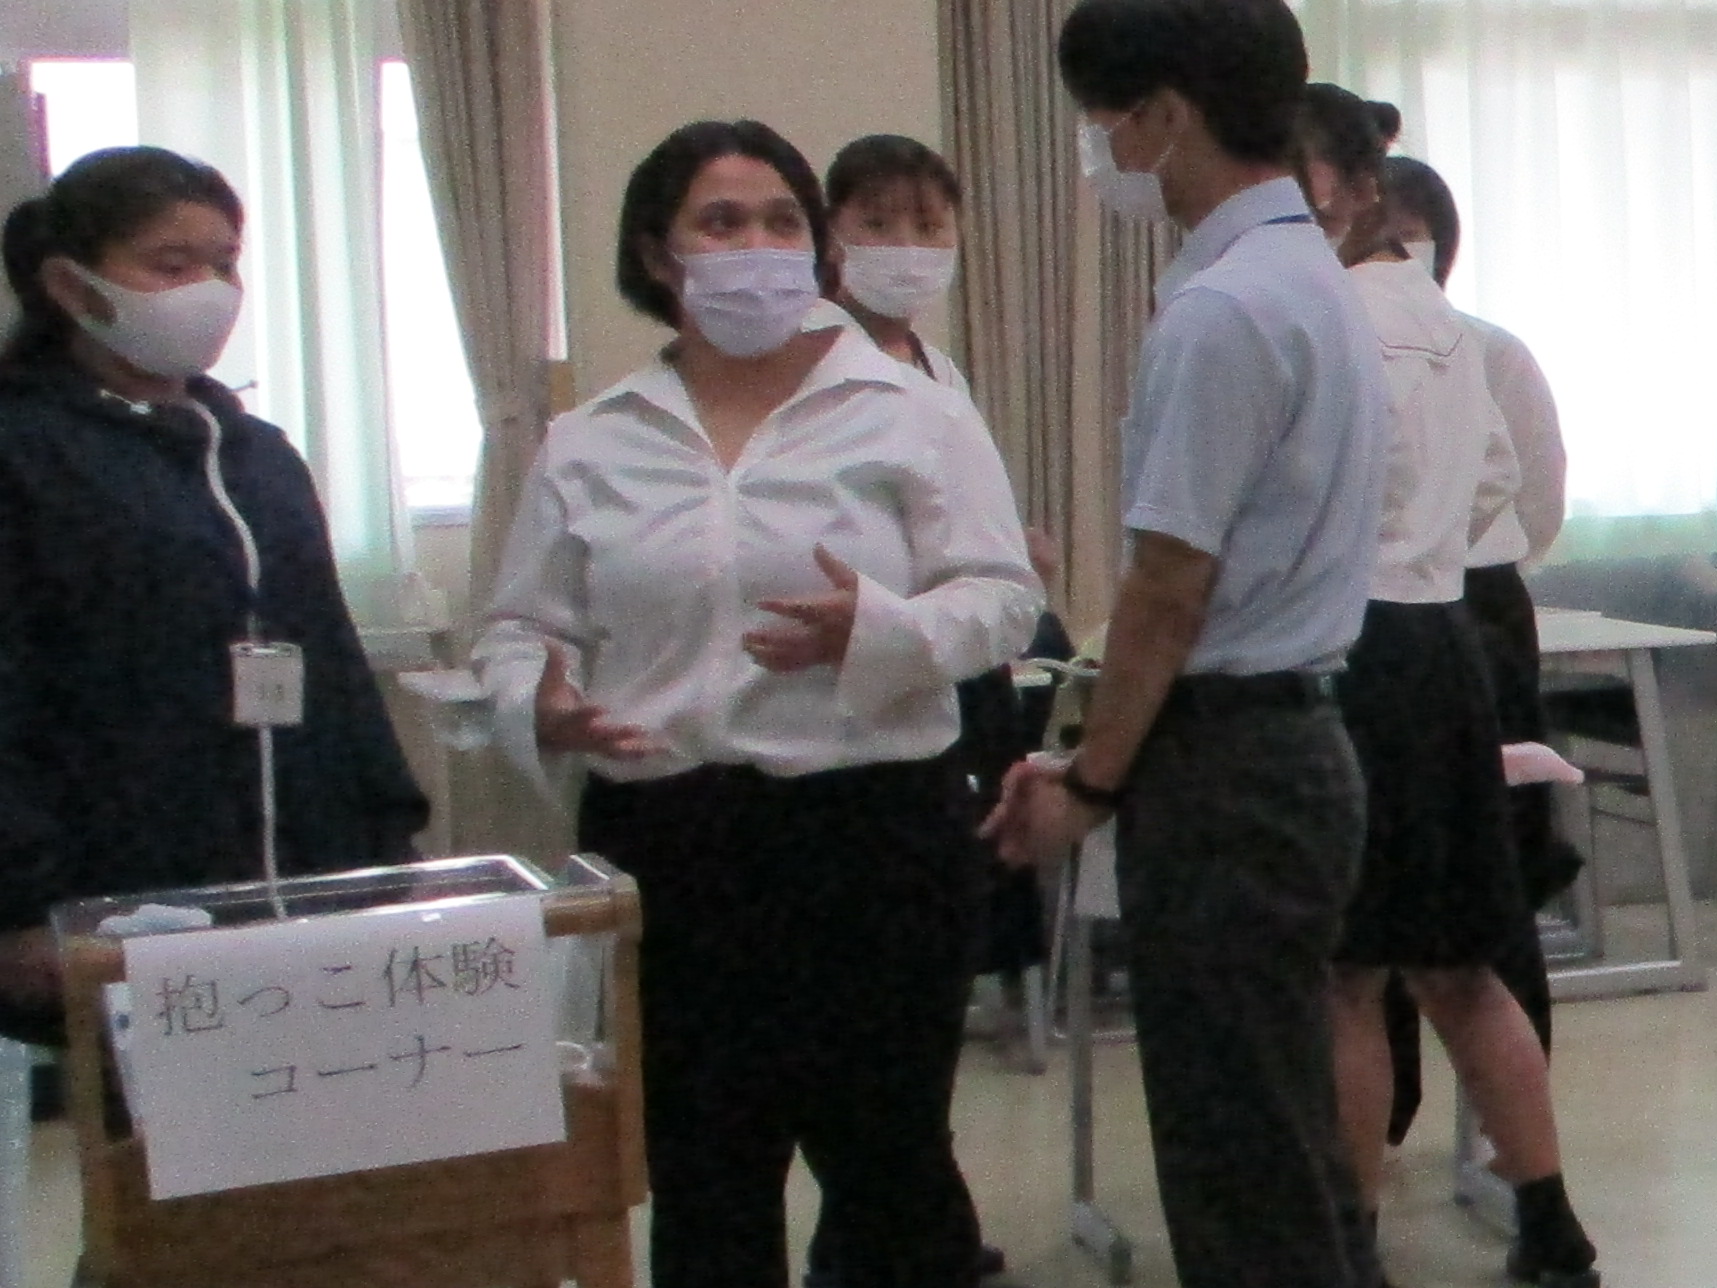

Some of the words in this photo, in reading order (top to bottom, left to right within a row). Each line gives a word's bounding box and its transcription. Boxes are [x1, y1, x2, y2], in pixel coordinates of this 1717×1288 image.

[156, 936, 519, 1037] 抱っこ体験
[250, 1034, 524, 1100] コーナー
